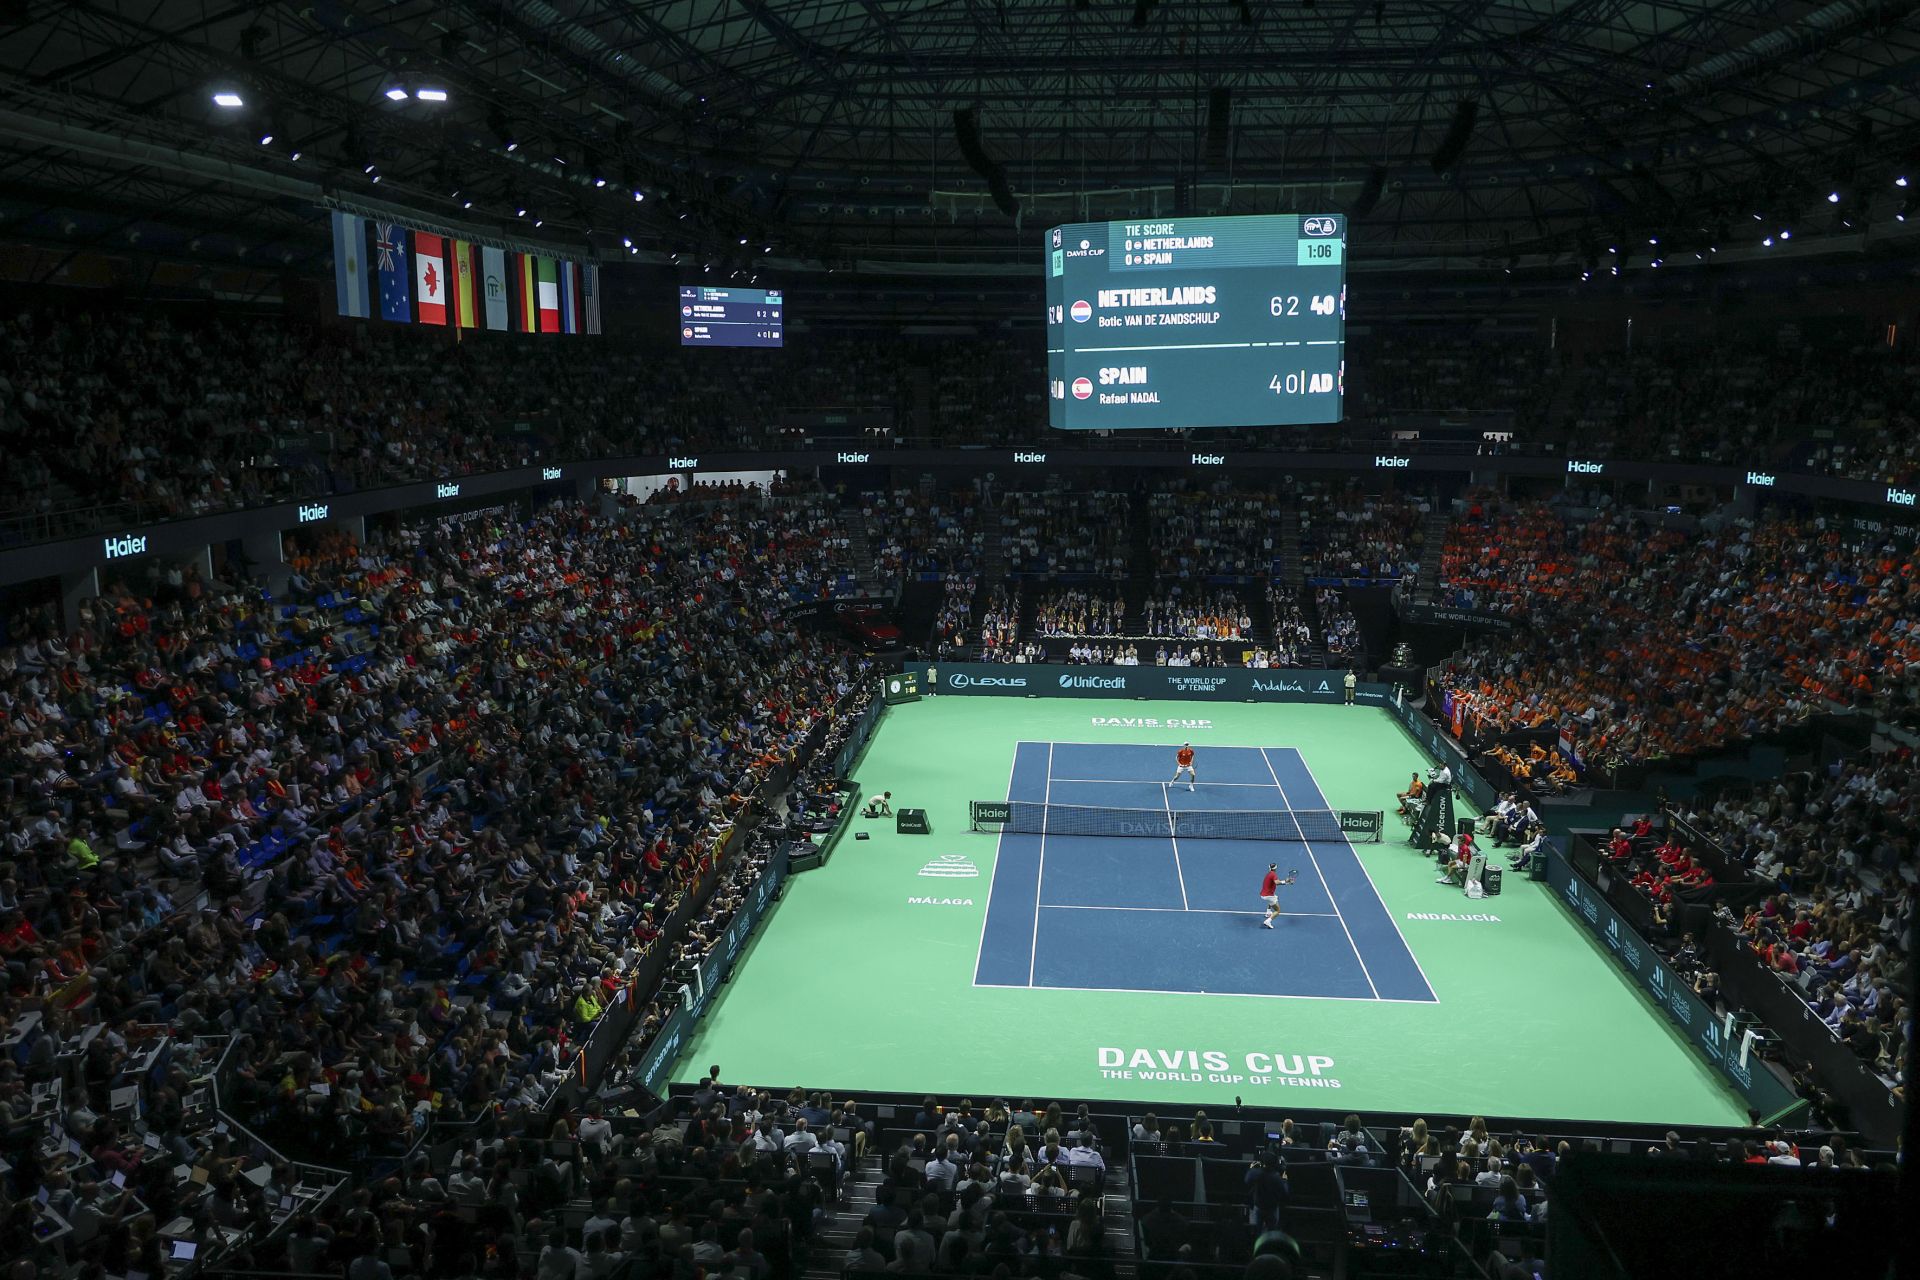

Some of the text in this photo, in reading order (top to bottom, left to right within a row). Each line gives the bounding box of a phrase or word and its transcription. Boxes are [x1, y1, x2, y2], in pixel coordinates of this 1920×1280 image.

[1125, 224, 1175, 236] TIE SCORE
[1143, 236, 1214, 250] NETHERLANDS
[1088, 249, 1105, 257] CUP
[1307, 245, 1332, 258] 1:06
[1143, 252, 1173, 265] SPAIN
[487, 283, 499, 297] ITF
[1098, 286, 1216, 307] NETHERLANDS
[1310, 295, 1335, 315] 40
[1099, 312, 1220, 327] Botic VAN DE ZANDSCHULP
[1099, 366, 1147, 385] SPAIN
[1309, 373, 1334, 393] AD
[1100, 392, 1160, 404] Rafael NADAL
[669, 456, 698, 469] Haier
[837, 451, 870, 463] Haier
[1014, 451, 1046, 463] Haier
[1191, 453, 1225, 465] Haier
[1375, 455, 1410, 468] Haier
[543, 466, 562, 481] Haier
[1567, 460, 1604, 474] Haier
[1746, 471, 1775, 487] Haier
[437, 482, 460, 498] Haier
[1886, 487, 1916, 505] Haier
[298, 504, 329, 523] Haier
[104, 533, 147, 559] Haier
[1448, 613, 1472, 622] WORLD
[970, 678, 1027, 687] LEXUS
[1074, 676, 1126, 689] UniCredit
[1183, 677, 1209, 685] WORLD
[1252, 678, 1304, 693] Andalucía
[1091, 717, 1159, 725] DAVIS
[979, 809, 1008, 818] Haier
[1343, 817, 1374, 828] Haier
[908, 896, 973, 905] MÁLAGA
[1407, 912, 1502, 922] ANDALUCÍA
[1098, 1047, 1335, 1076] DAVIS CUP
[1100, 1069, 1342, 1089] THE WORLD CUP OF TENNIS
